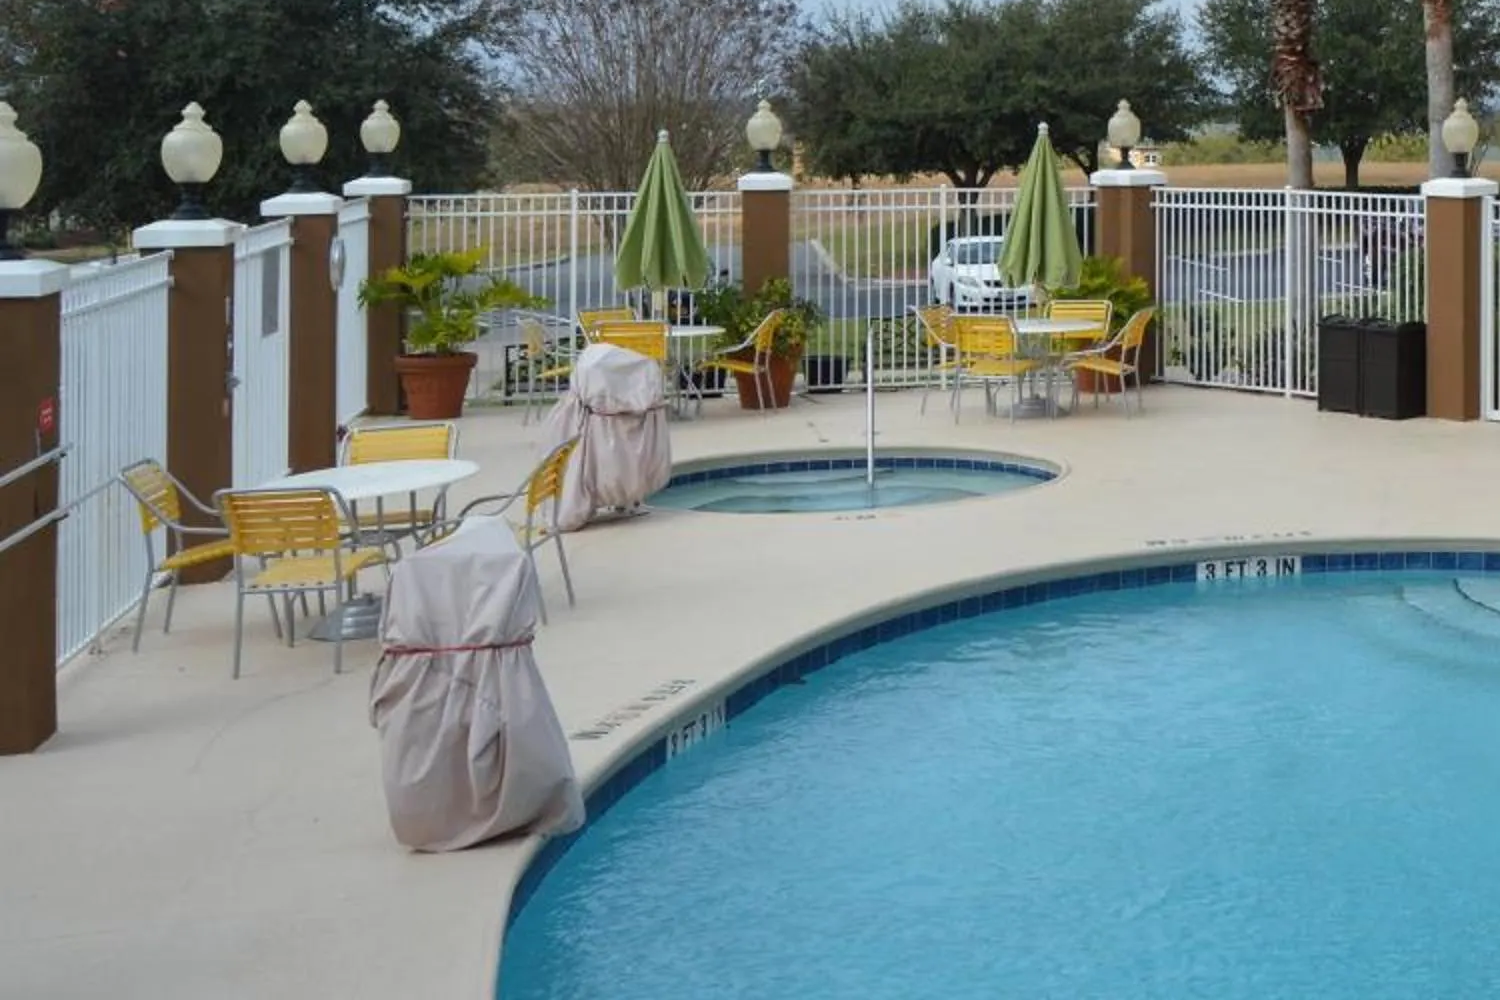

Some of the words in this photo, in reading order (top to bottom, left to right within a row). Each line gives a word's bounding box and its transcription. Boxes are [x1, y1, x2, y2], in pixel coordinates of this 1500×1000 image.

[1205, 563, 1216, 580] 3
[1225, 560, 1247, 578] FT
[1256, 558, 1268, 577] 3
[1275, 557, 1295, 576] IN
